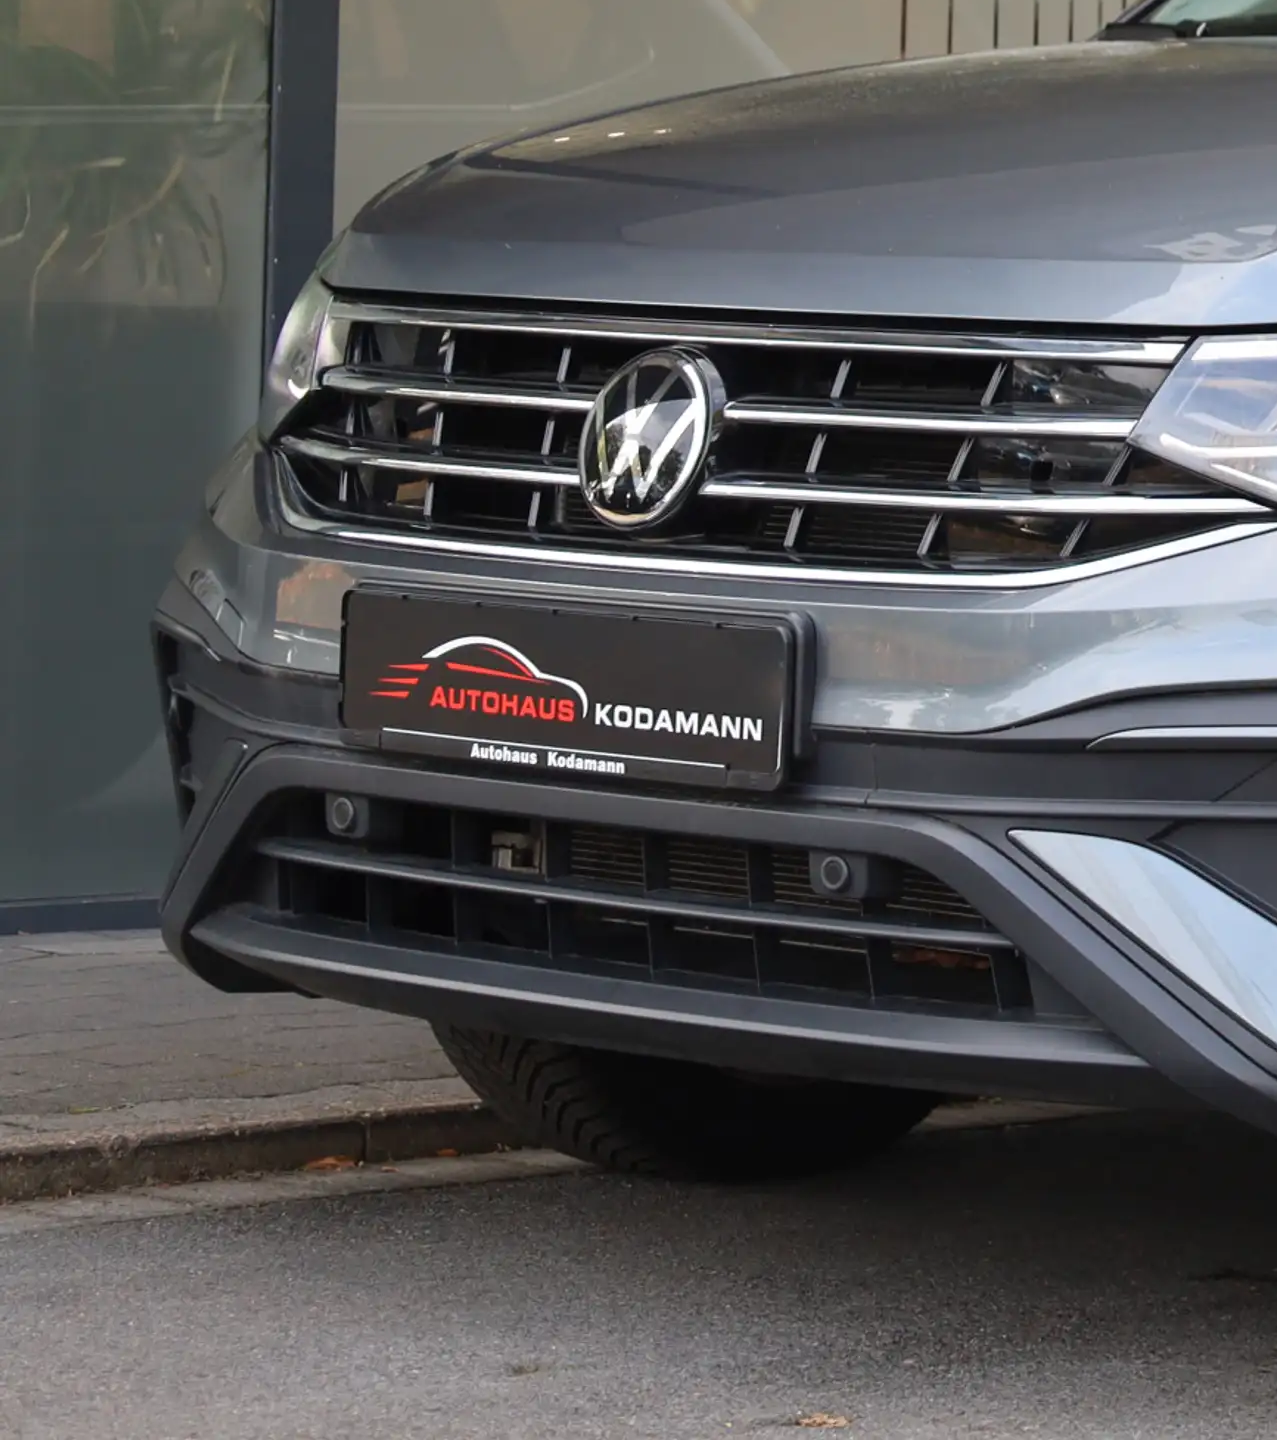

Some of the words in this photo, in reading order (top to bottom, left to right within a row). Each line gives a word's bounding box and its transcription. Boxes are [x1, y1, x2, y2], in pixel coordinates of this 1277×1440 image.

[429, 685, 575, 723] AUTOHAUS
[594, 702, 763, 742] KODAMANN
[470, 742, 538, 766] Autohaus
[547, 750, 626, 776] Kodamann
